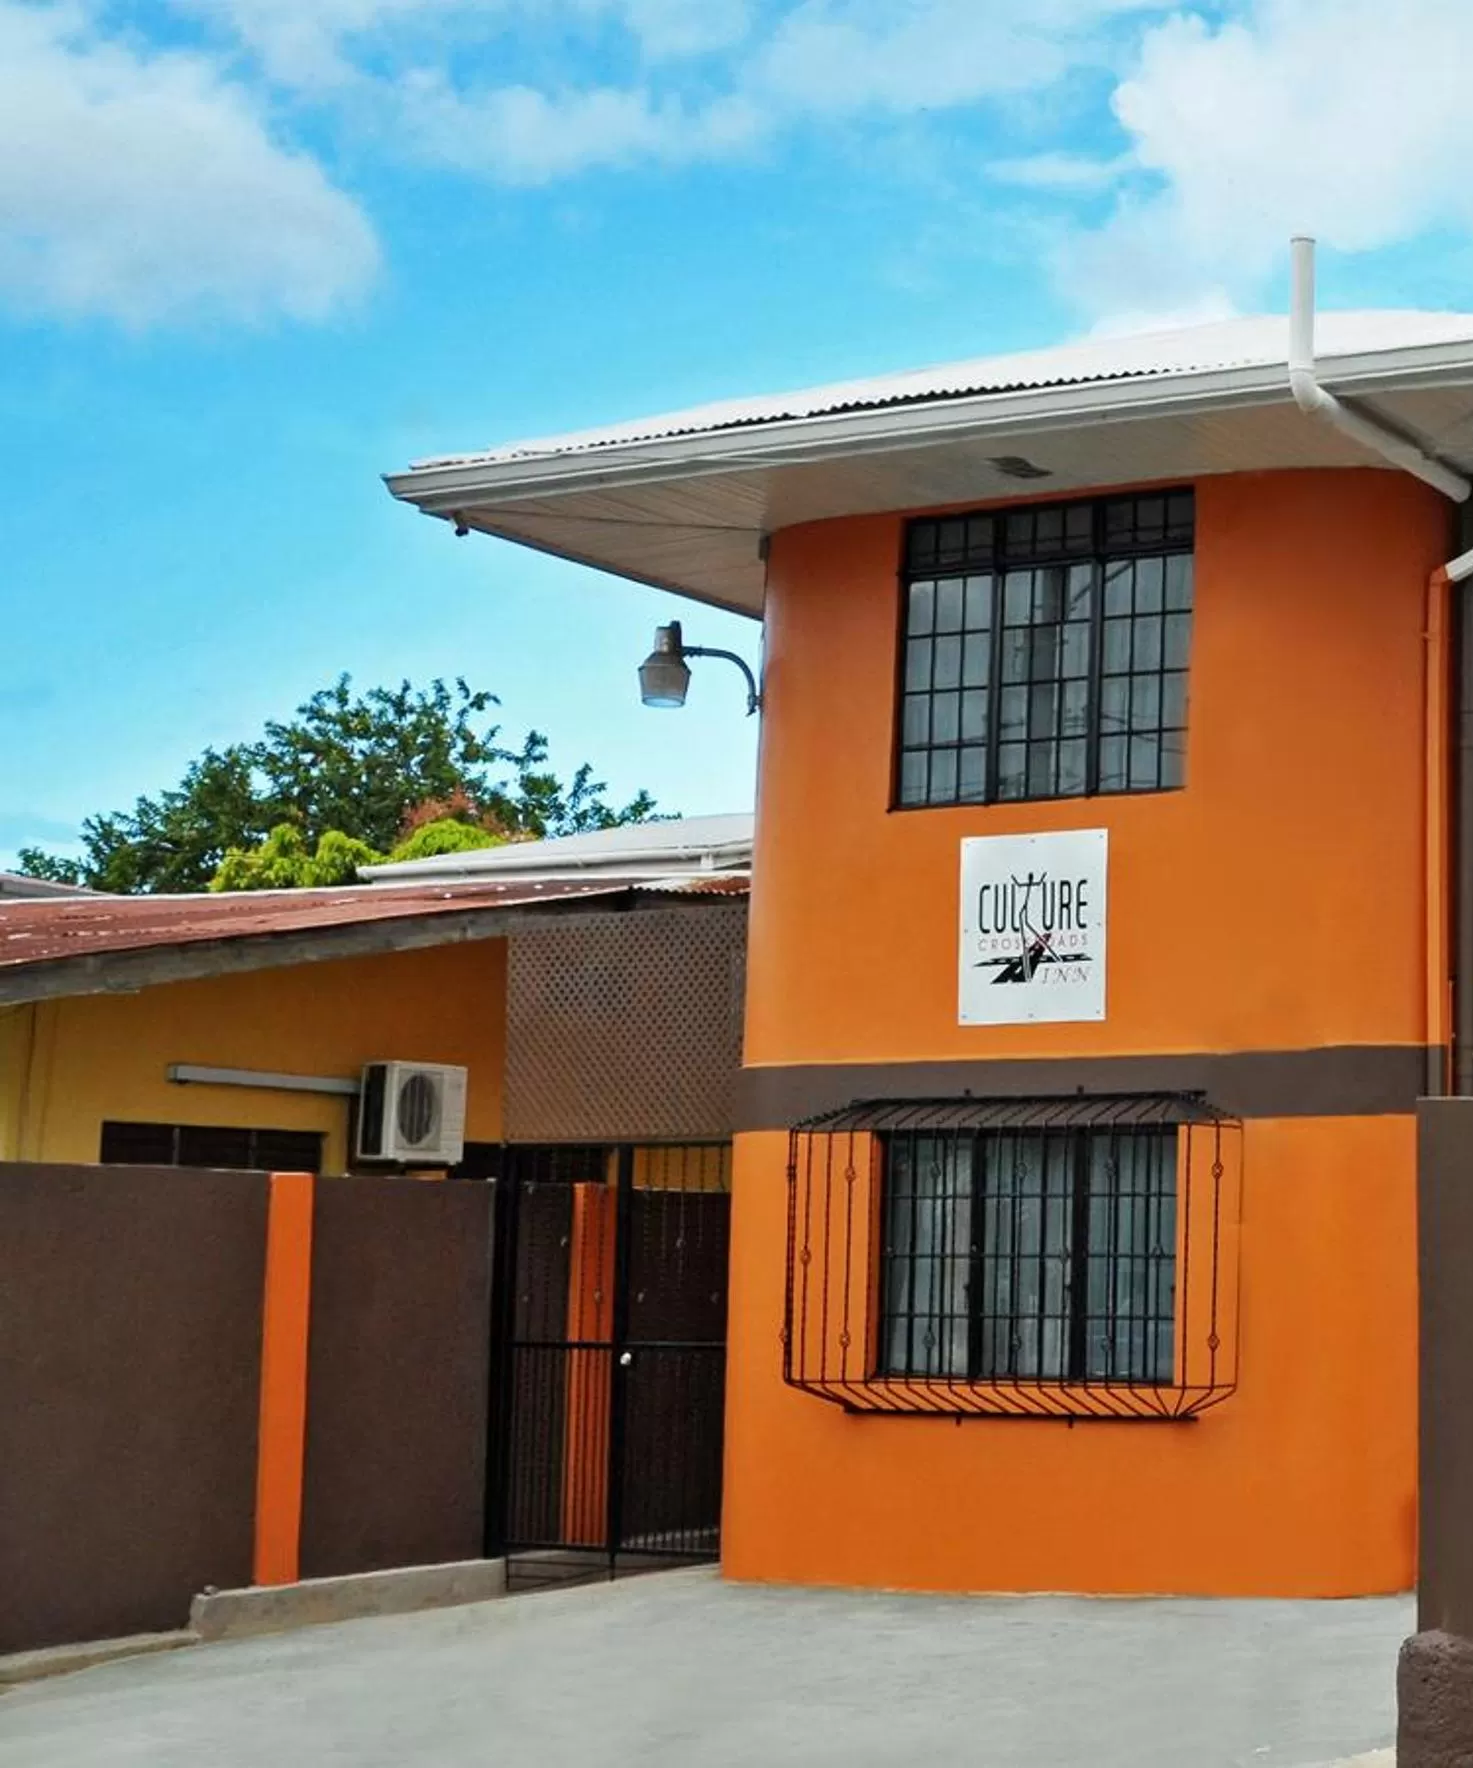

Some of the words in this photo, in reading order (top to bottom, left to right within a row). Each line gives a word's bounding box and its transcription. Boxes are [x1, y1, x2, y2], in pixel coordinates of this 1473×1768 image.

[978, 877, 1089, 934] CULTURE
[977, 933, 1088, 951] CROSSADS
[1039, 966, 1092, 985] INN
